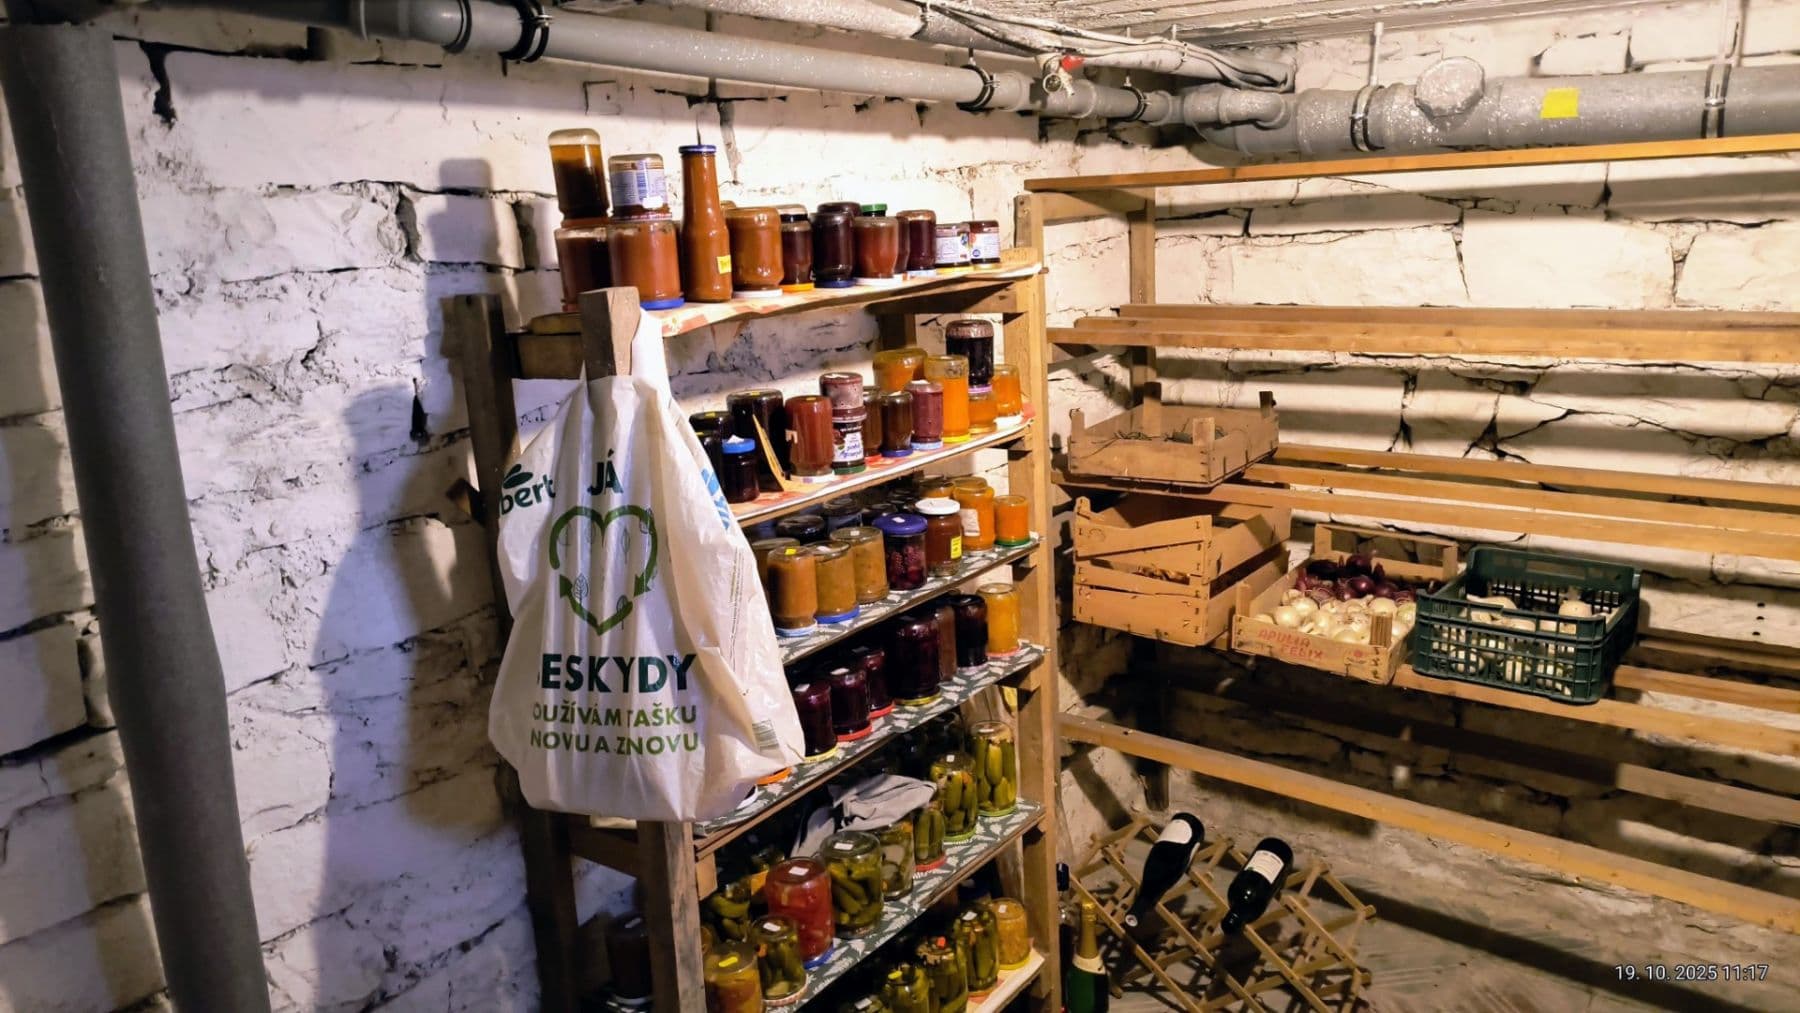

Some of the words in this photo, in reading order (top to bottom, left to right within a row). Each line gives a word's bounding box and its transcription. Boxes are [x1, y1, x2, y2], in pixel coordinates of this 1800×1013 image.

[587, 448, 624, 496] JÁ
[538, 653, 697, 693] ESKYDY
[594, 735, 610, 753] A
